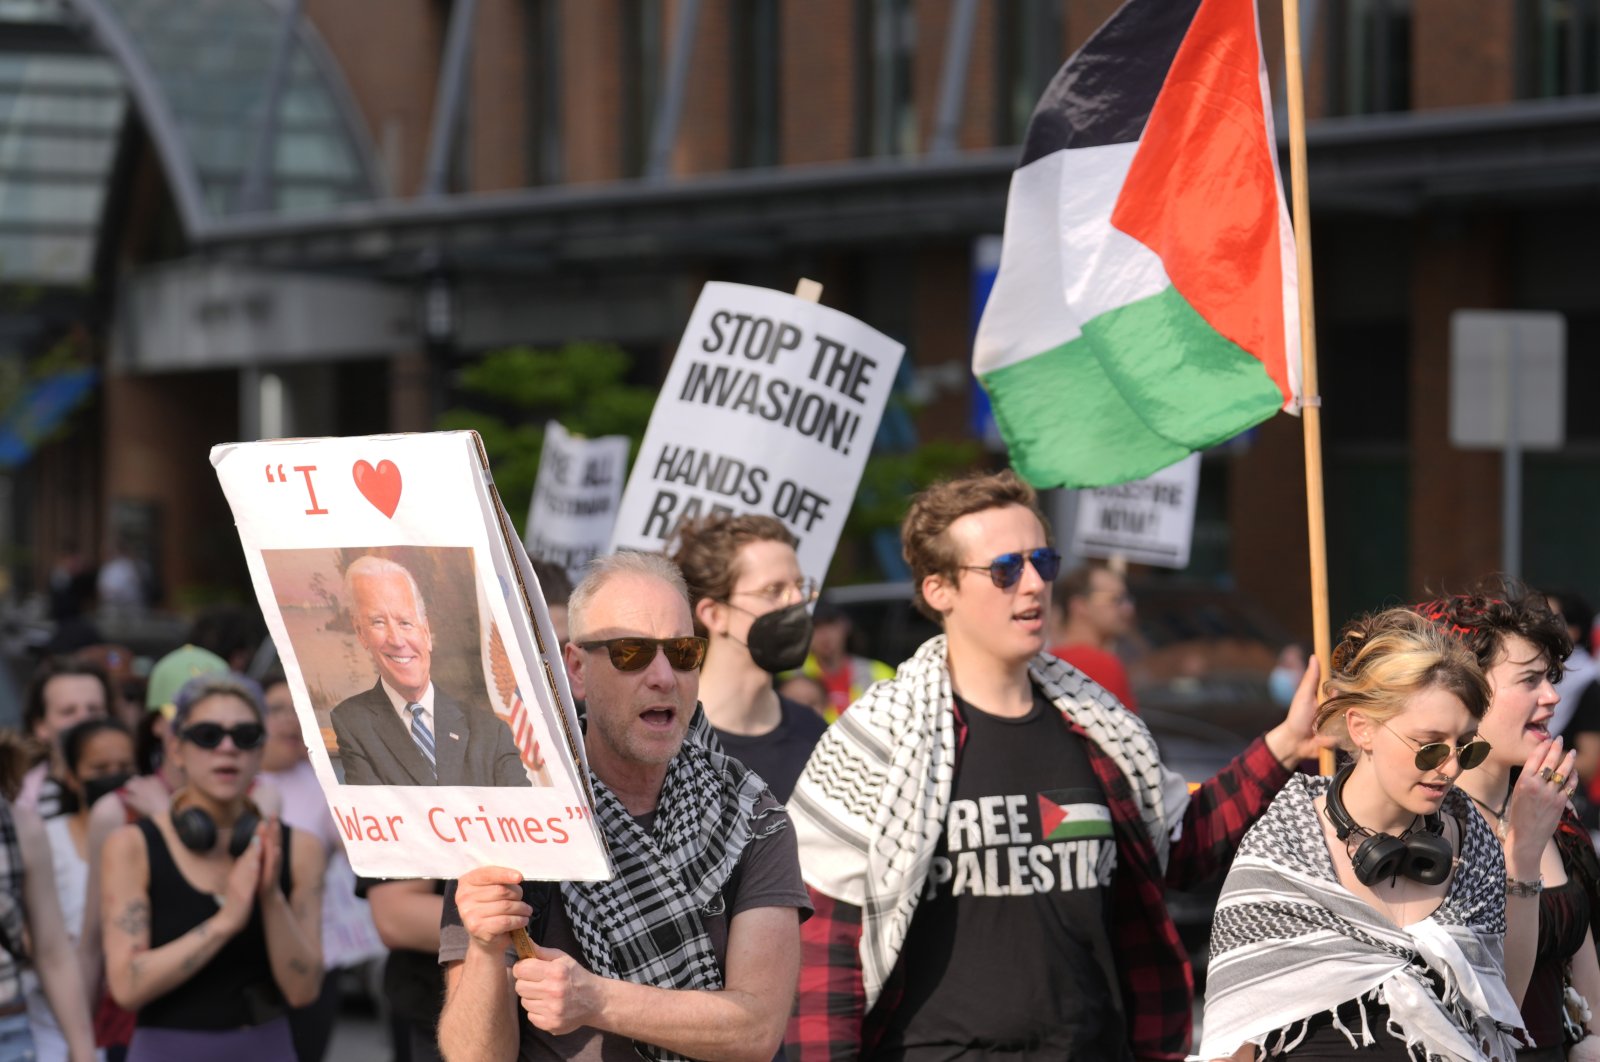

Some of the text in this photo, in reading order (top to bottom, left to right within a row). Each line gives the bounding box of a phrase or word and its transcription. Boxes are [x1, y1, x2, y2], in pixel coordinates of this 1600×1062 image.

[702, 311, 877, 404] STOP THE
[680, 362, 860, 455] INVASION!
[653, 444, 768, 506] HANDS
[772, 480, 830, 531] OFF
[333, 806, 403, 842] War
[947, 795, 1032, 851] REE
